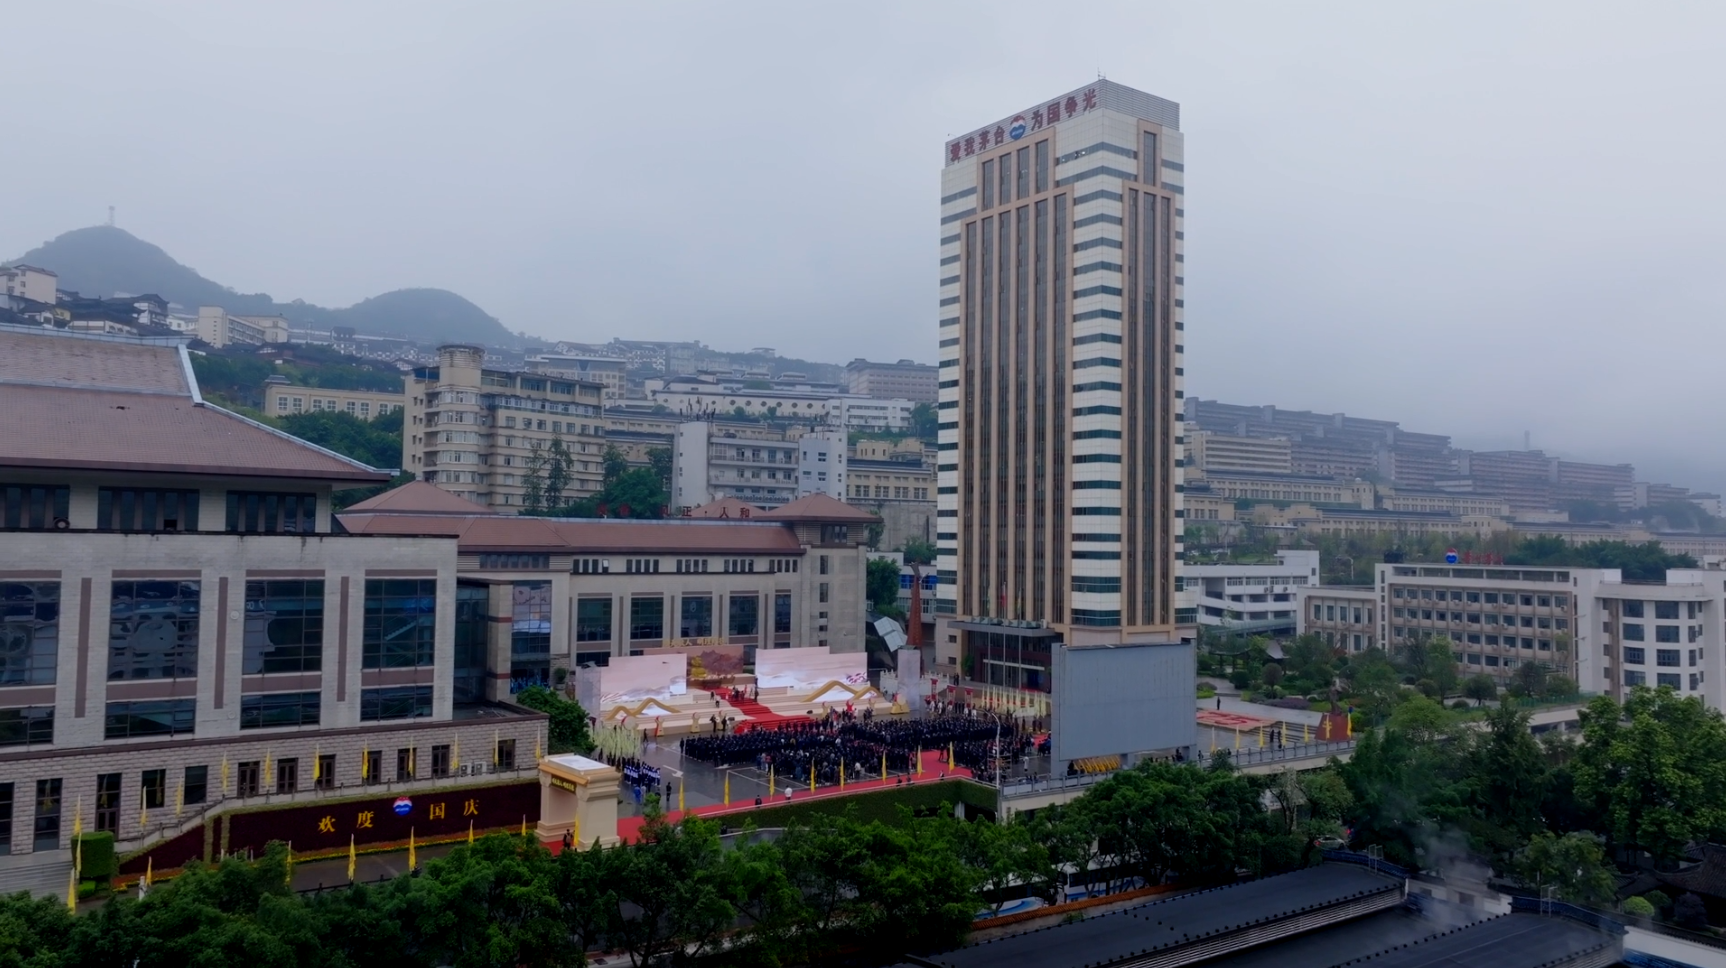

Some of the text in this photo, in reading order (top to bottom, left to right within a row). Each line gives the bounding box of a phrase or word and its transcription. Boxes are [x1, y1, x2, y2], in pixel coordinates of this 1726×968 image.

[950, 88, 1096, 162] 爱我茅台 为国争光
[318, 799, 480, 834] 欢度 国庆
